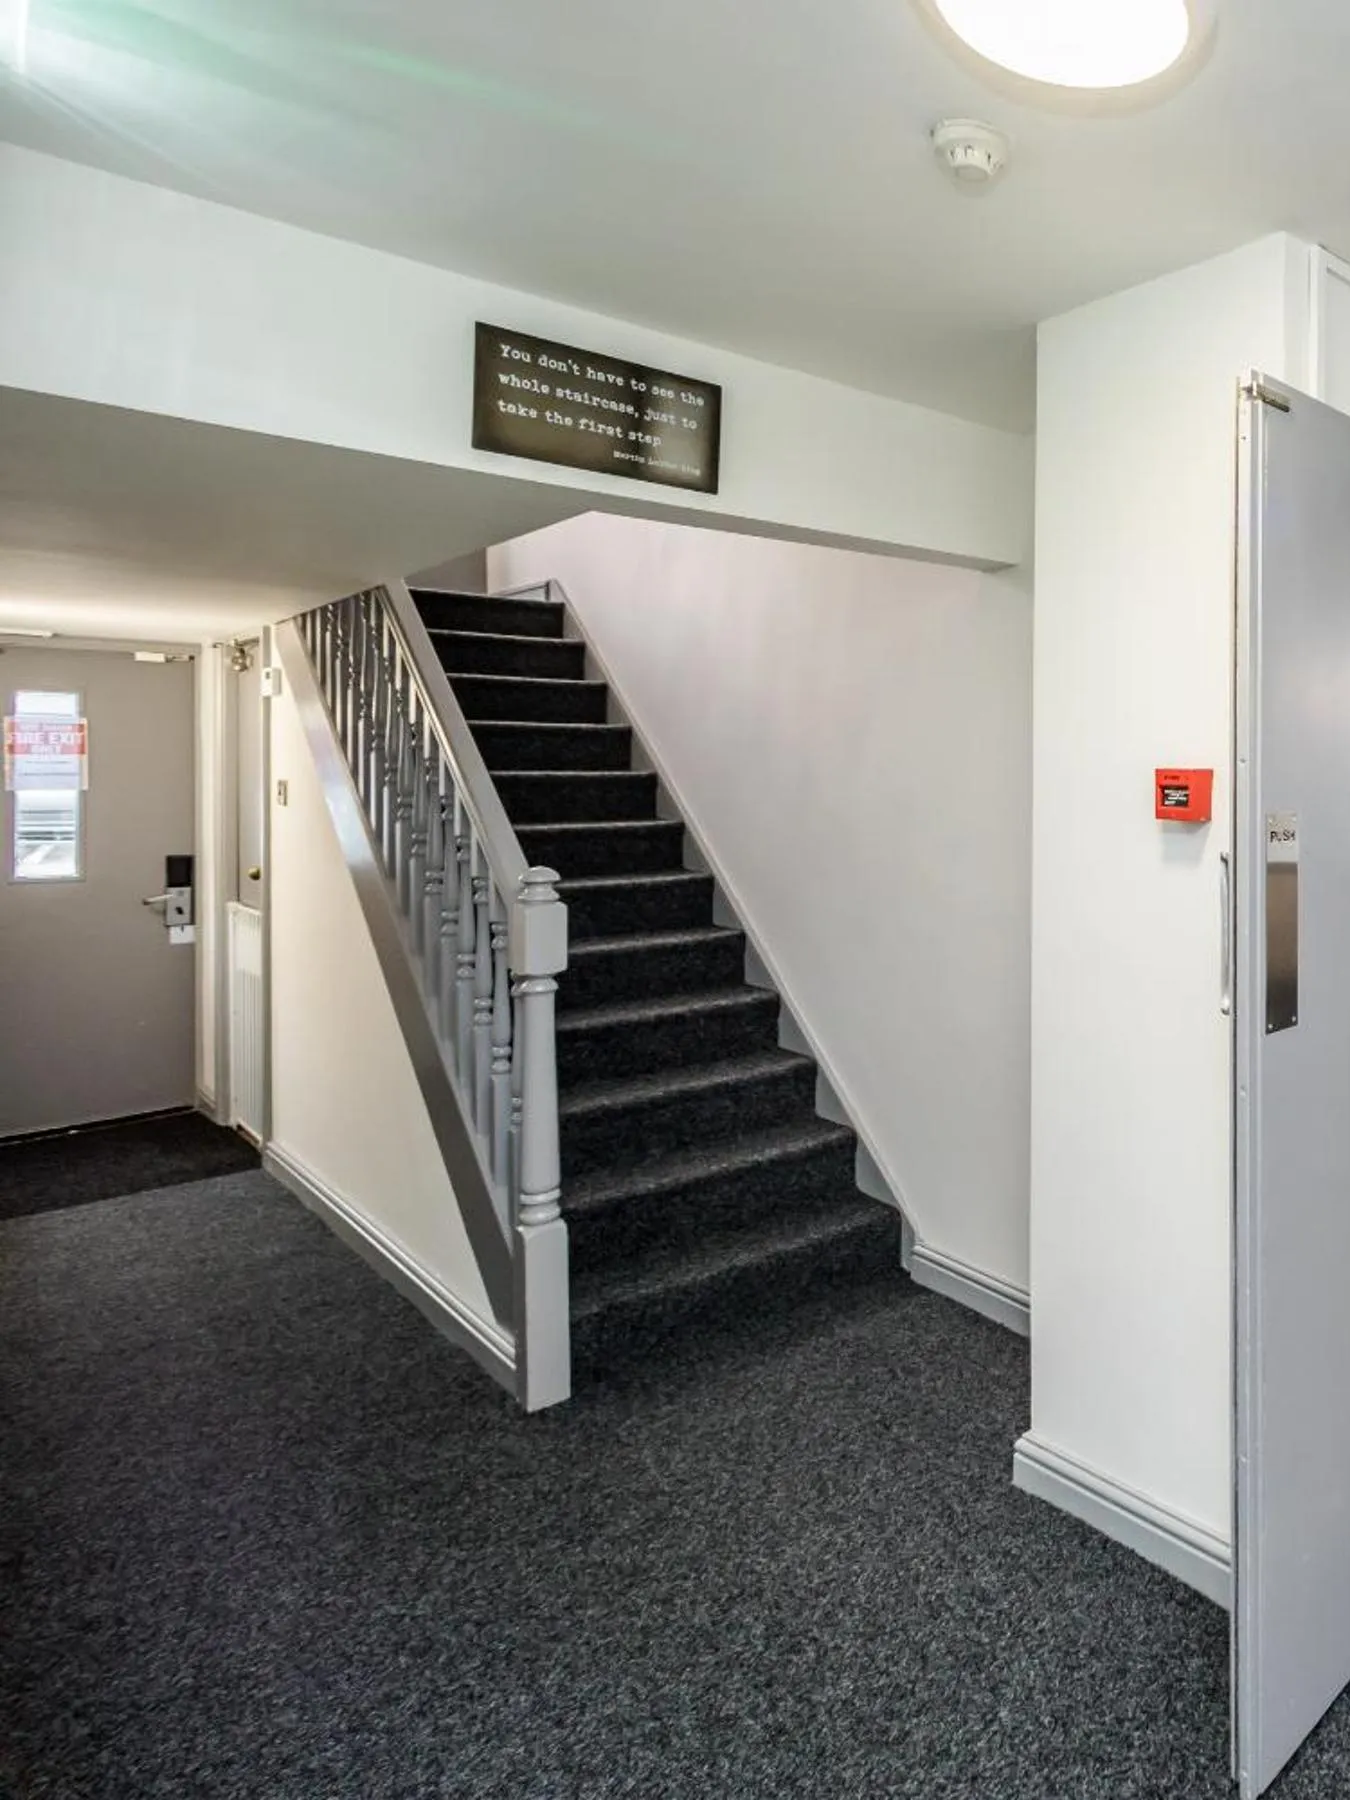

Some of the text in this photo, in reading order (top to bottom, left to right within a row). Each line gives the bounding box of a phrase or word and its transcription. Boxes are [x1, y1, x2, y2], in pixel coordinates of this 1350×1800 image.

[498, 373, 698, 430] whole staircase, just to
[499, 343, 704, 407] You don't have to see the
[498, 399, 662, 448] take the first step
